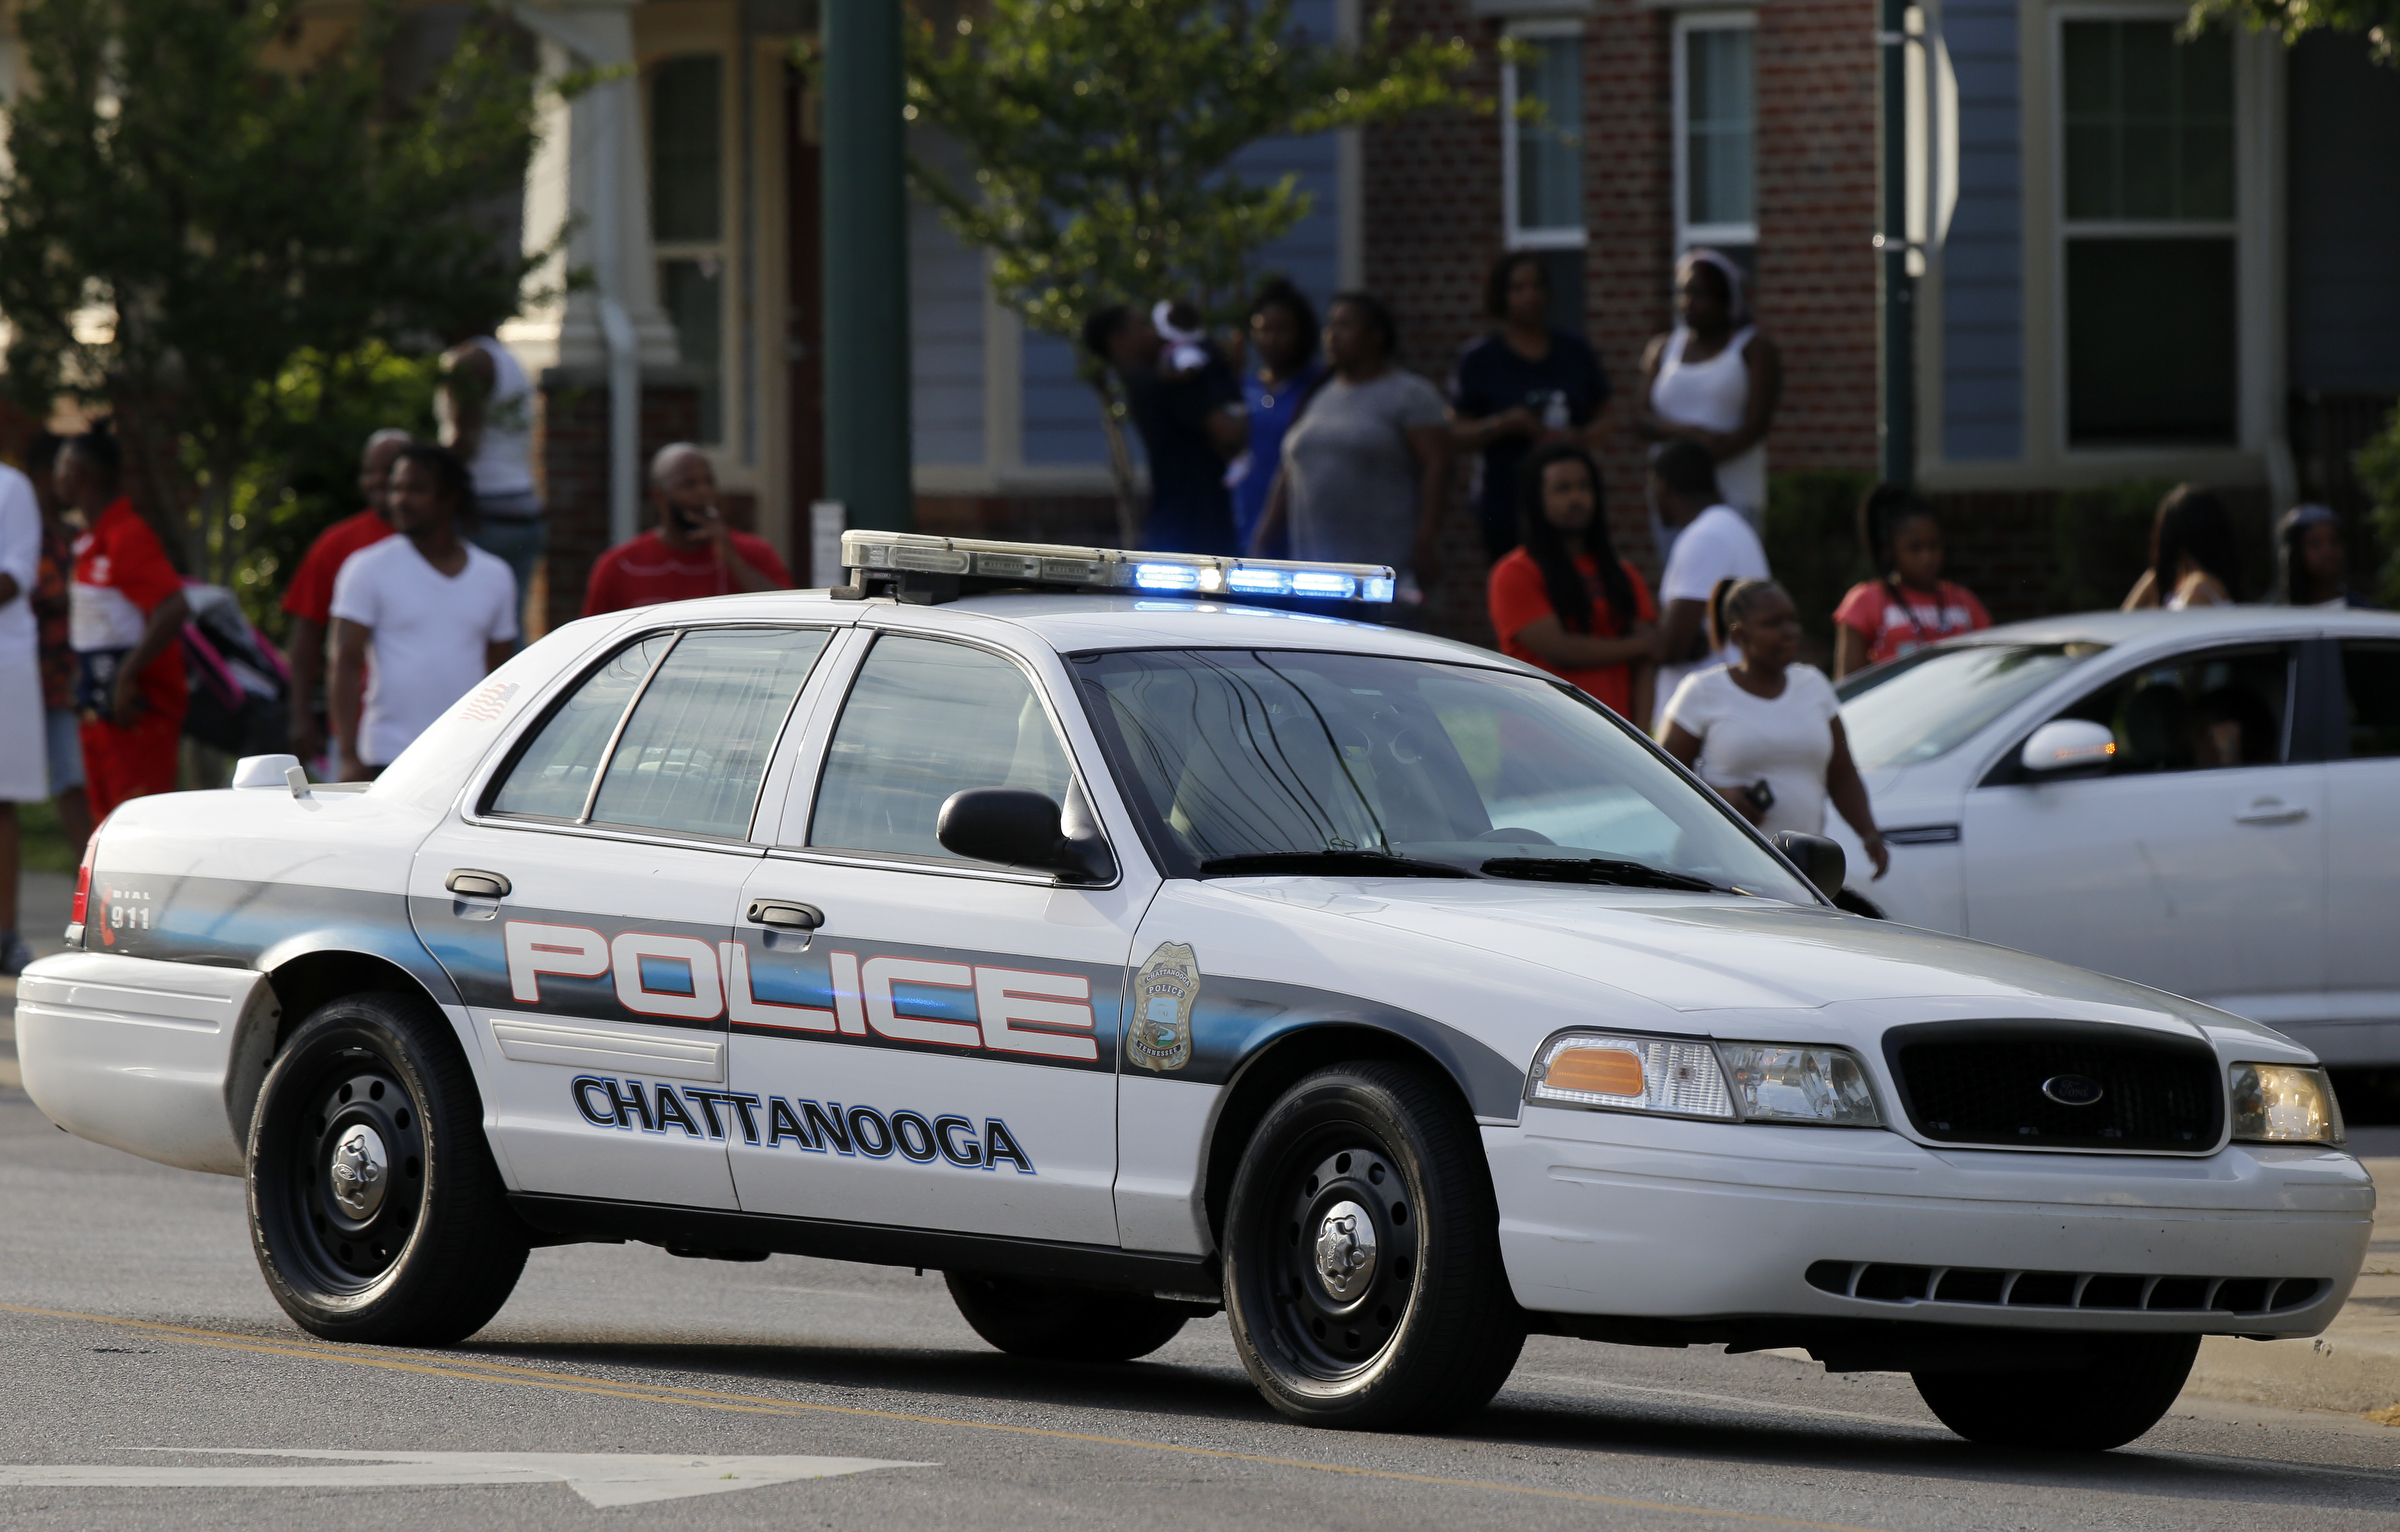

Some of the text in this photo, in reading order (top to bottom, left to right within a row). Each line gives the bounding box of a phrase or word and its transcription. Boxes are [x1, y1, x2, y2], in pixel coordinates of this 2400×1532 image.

[113, 890, 150, 900] DIAL
[111, 905, 150, 930] 911
[1146, 969, 1190, 987] CHATTANOOGA
[504, 920, 1099, 1061] POLICE
[1148, 984, 1183, 998] POLICE
[1138, 1043, 1178, 1057] TENNESSEE
[2059, 1080, 2090, 1097] Ford
[571, 1074, 1037, 1175] CHATTANOOGA
